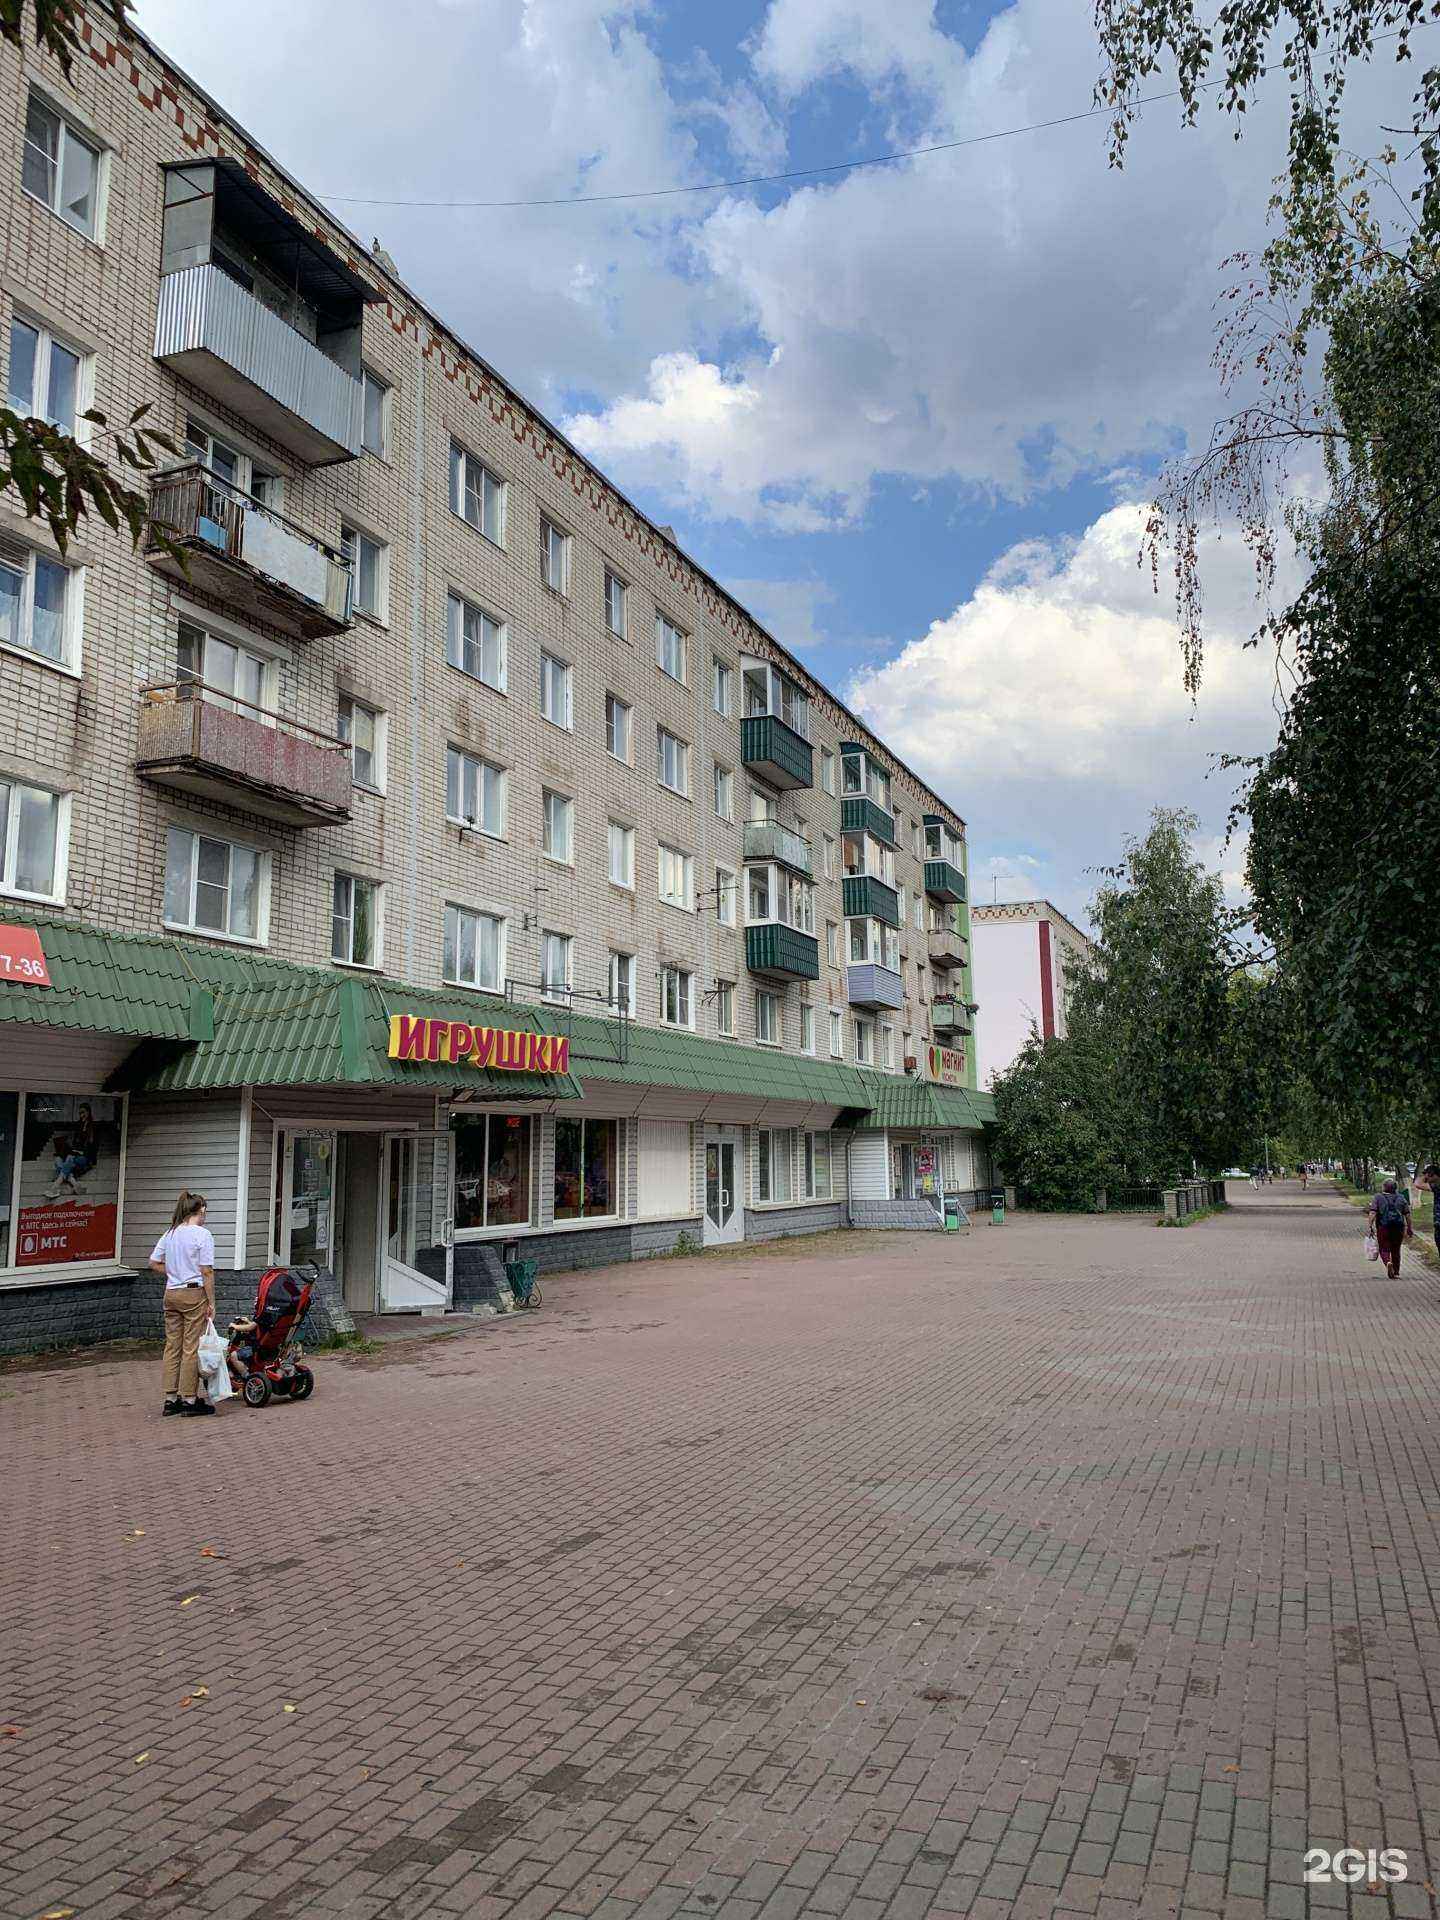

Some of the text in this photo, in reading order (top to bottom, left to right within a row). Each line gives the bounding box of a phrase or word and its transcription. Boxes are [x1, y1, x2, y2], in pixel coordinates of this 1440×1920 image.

[395, 1015, 570, 1074] ИГРУШКИ
[25, 1221, 40, 1230] МТС
[40, 1236, 68, 1250] МТС
